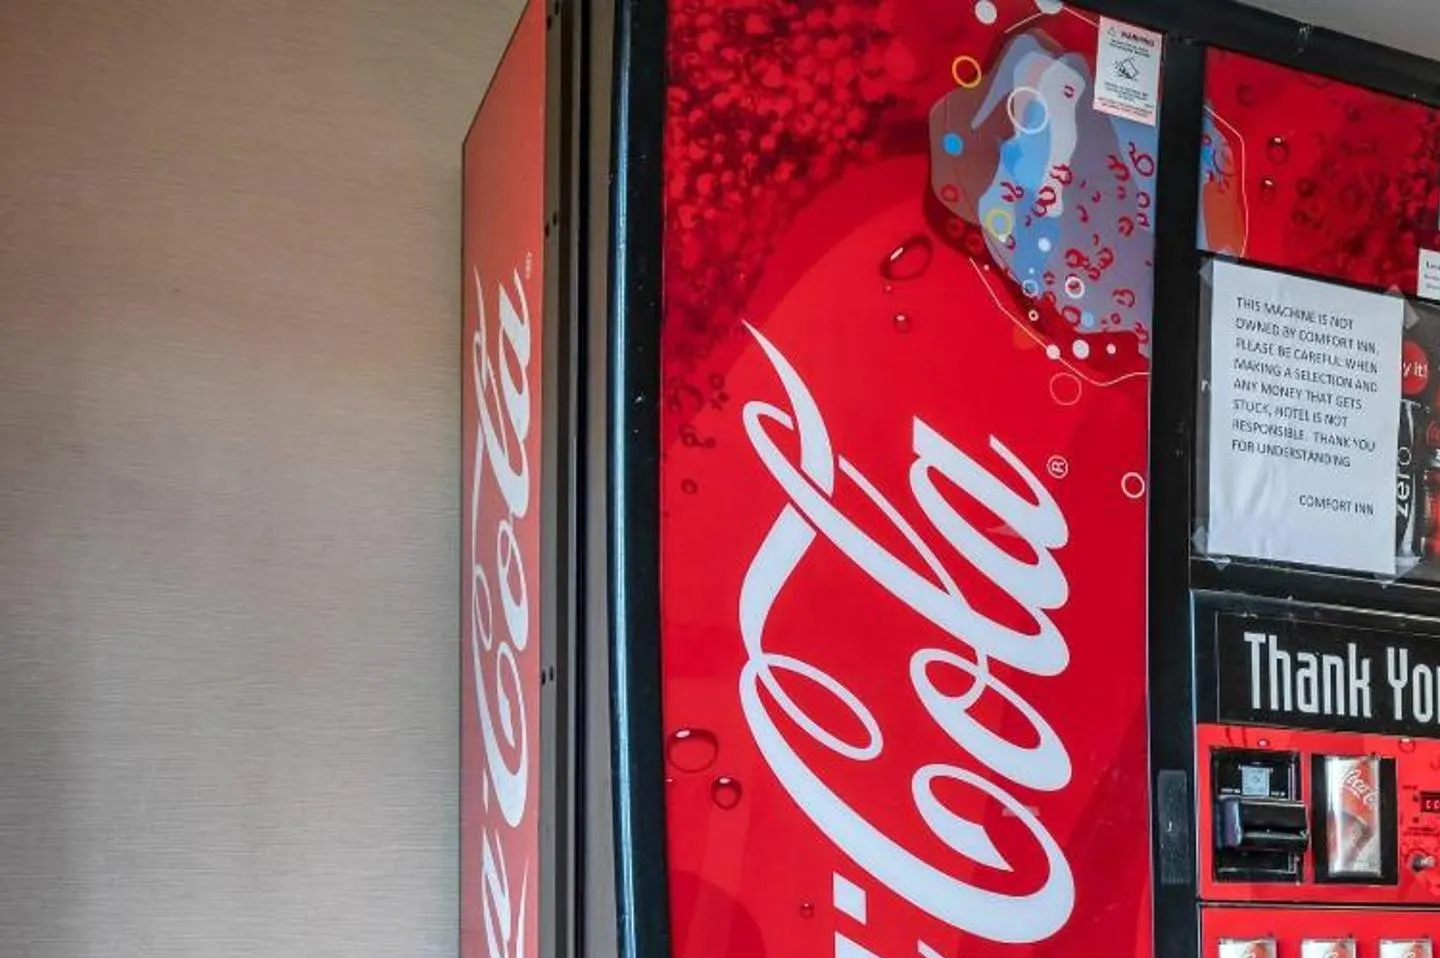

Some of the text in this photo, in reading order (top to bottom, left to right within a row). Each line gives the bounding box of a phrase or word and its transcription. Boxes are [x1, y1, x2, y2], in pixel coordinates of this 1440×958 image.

[1237, 297, 1354, 330] THIS MACHINE IS NOT
[1235, 317, 1280, 336] OWNED
[1282, 326, 1297, 338] BY
[1299, 329, 1353, 349] COMFORT
[1235, 337, 1378, 374] PLEASE BE CAREFUL WHEN
[1234, 358, 1378, 393] MAKING A SELECTION AND
[1234, 378, 1362, 410] ANY MONEY THAT GETS
[1312, 412, 1322, 424] IS
[1325, 414, 1349, 428] NOT
[1231, 439, 1351, 468] FOR UNDERSTANDING
[1313, 431, 1350, 449] THANK
[1353, 439, 1376, 453] YOU
[1299, 494, 1375, 515] COMFORT INN
[1243, 631, 1372, 719] Thank
